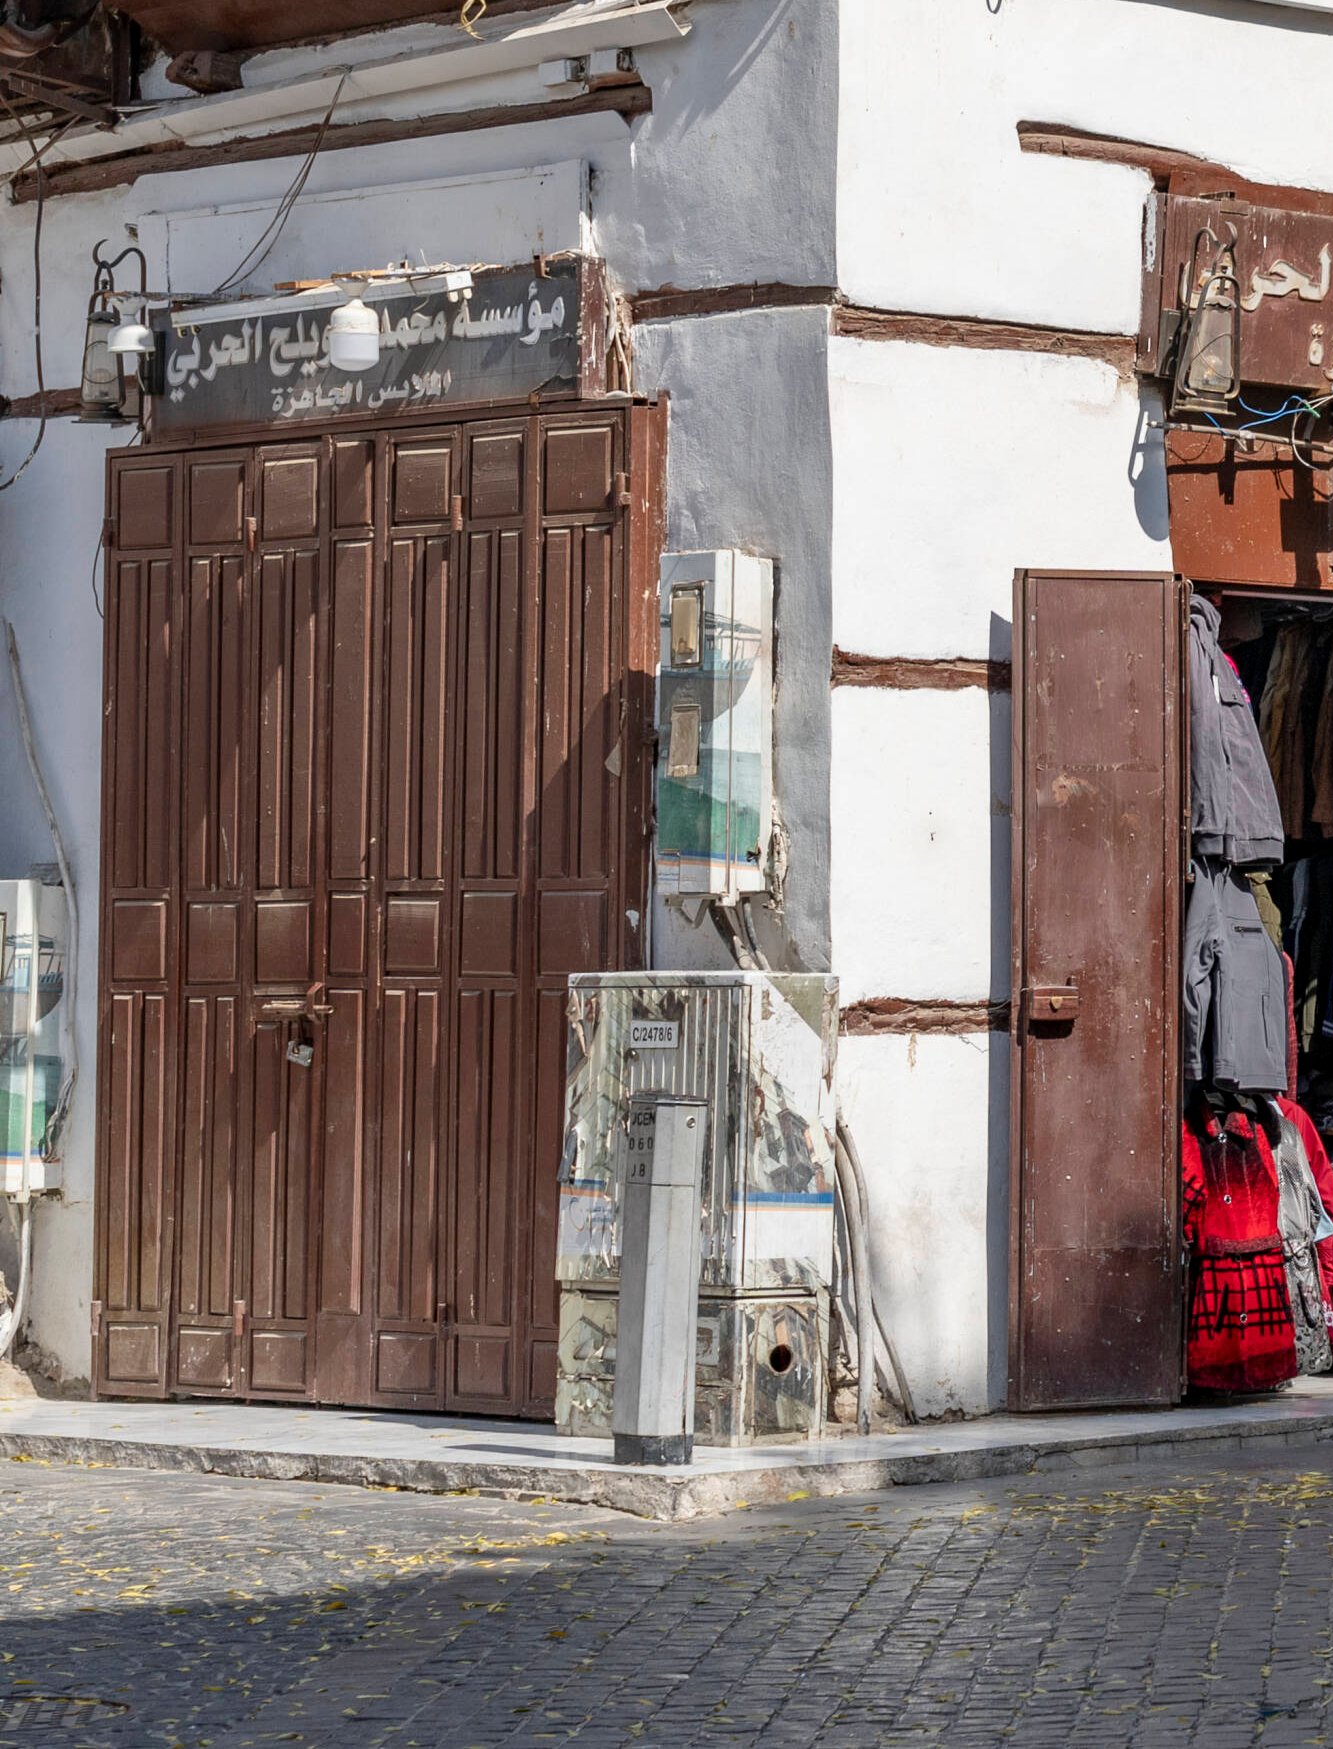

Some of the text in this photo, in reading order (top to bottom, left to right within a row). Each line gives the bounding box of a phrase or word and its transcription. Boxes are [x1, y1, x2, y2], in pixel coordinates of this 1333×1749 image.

[167, 315, 263, 403] الحربي
[270, 379, 363, 418] الجاهزة
[632, 1026, 673, 1042] C/2478/6
